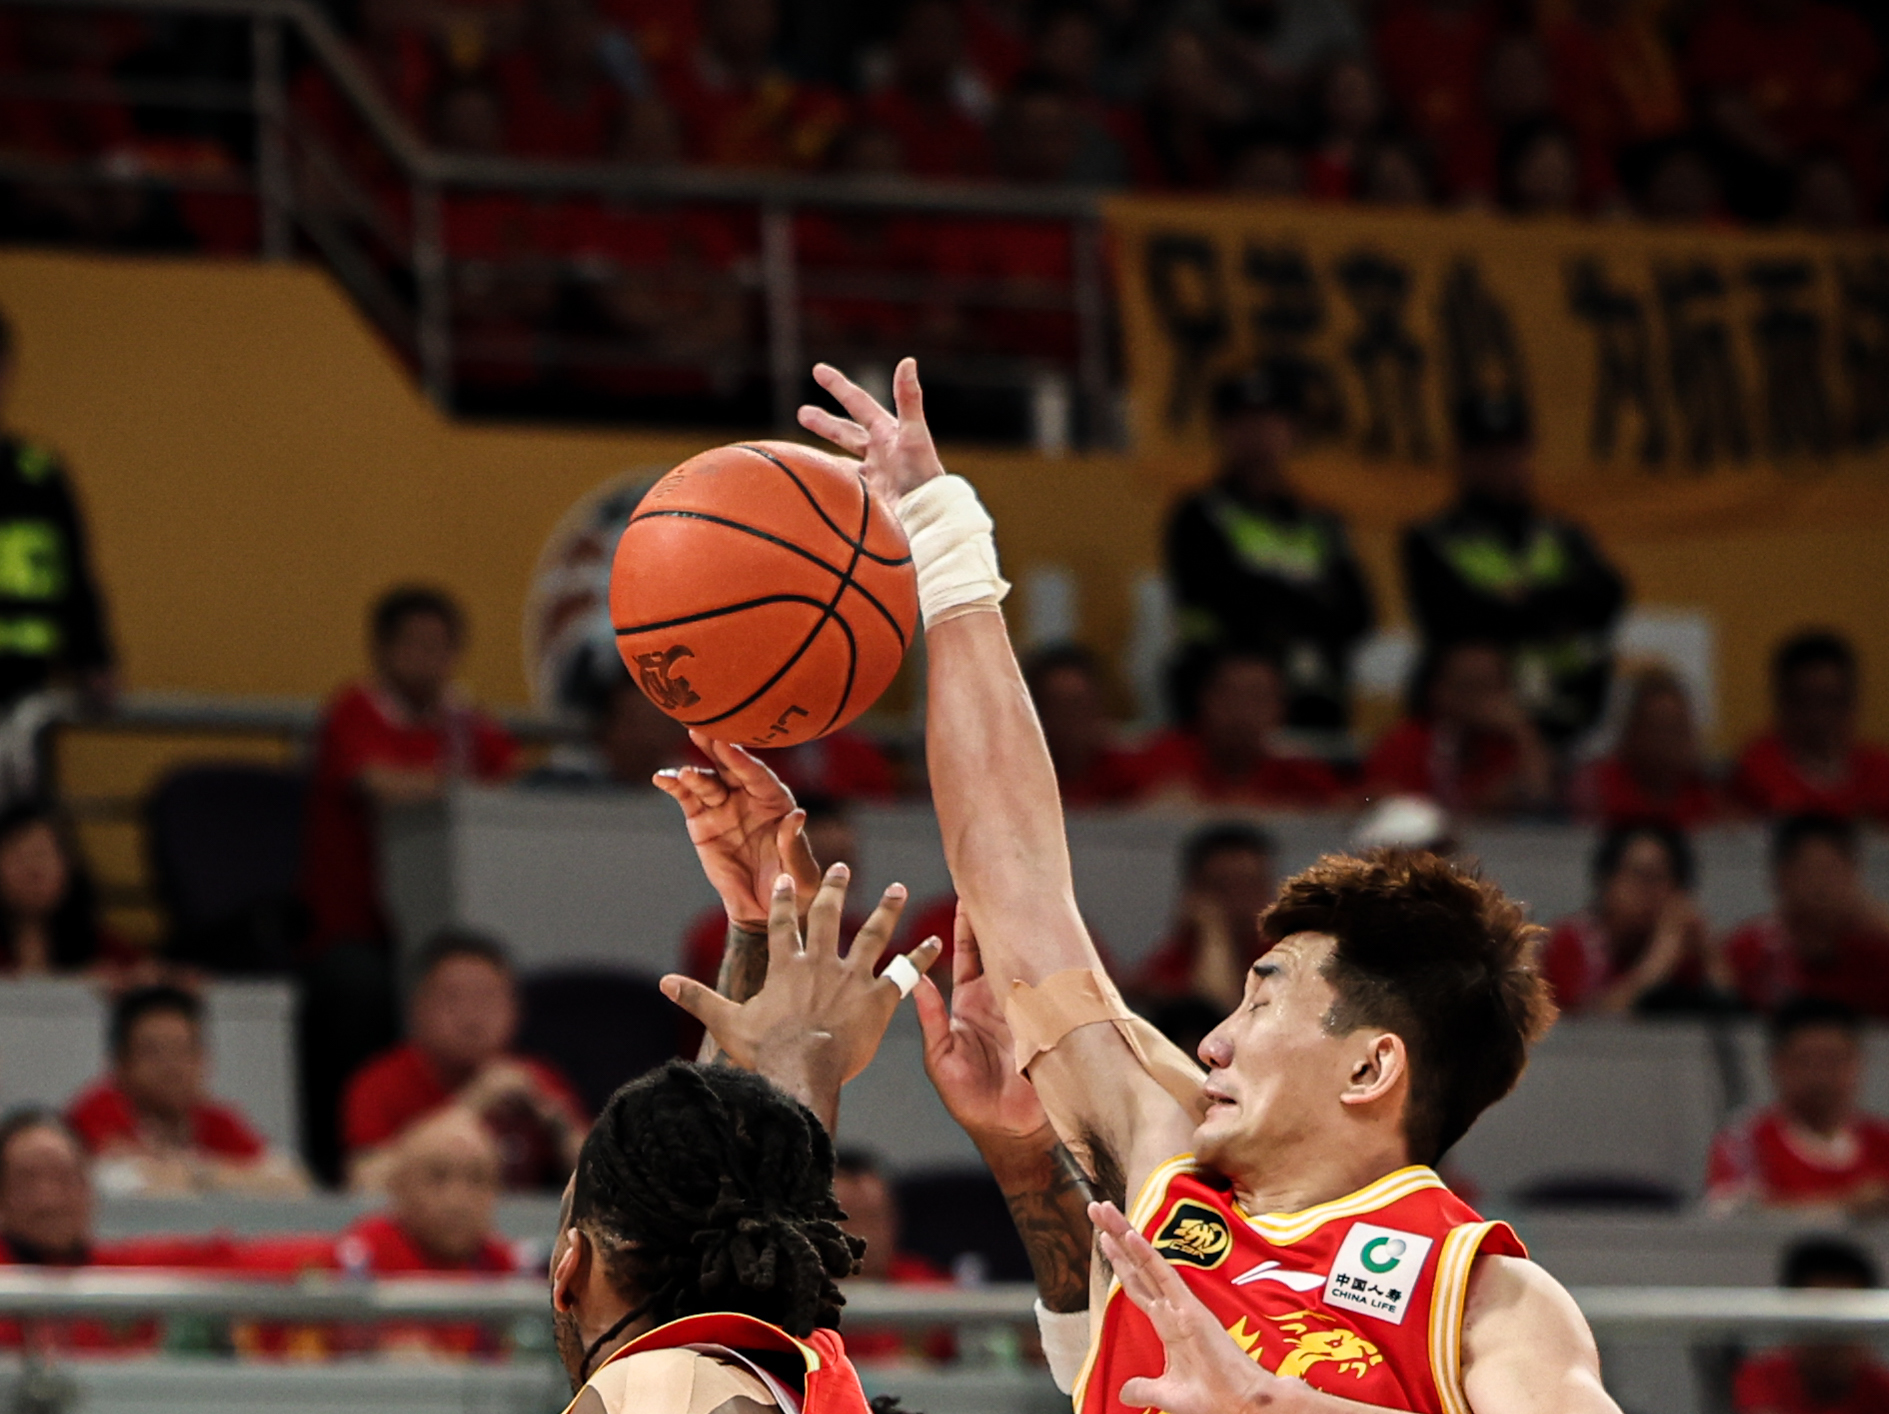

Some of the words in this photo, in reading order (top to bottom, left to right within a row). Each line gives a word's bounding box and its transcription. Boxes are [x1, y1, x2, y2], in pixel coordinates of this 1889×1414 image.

[1331, 1288, 1367, 1305] CHINA
[1371, 1296, 1397, 1314] LIFE
[1335, 1273, 1402, 1303] 中国人寿
